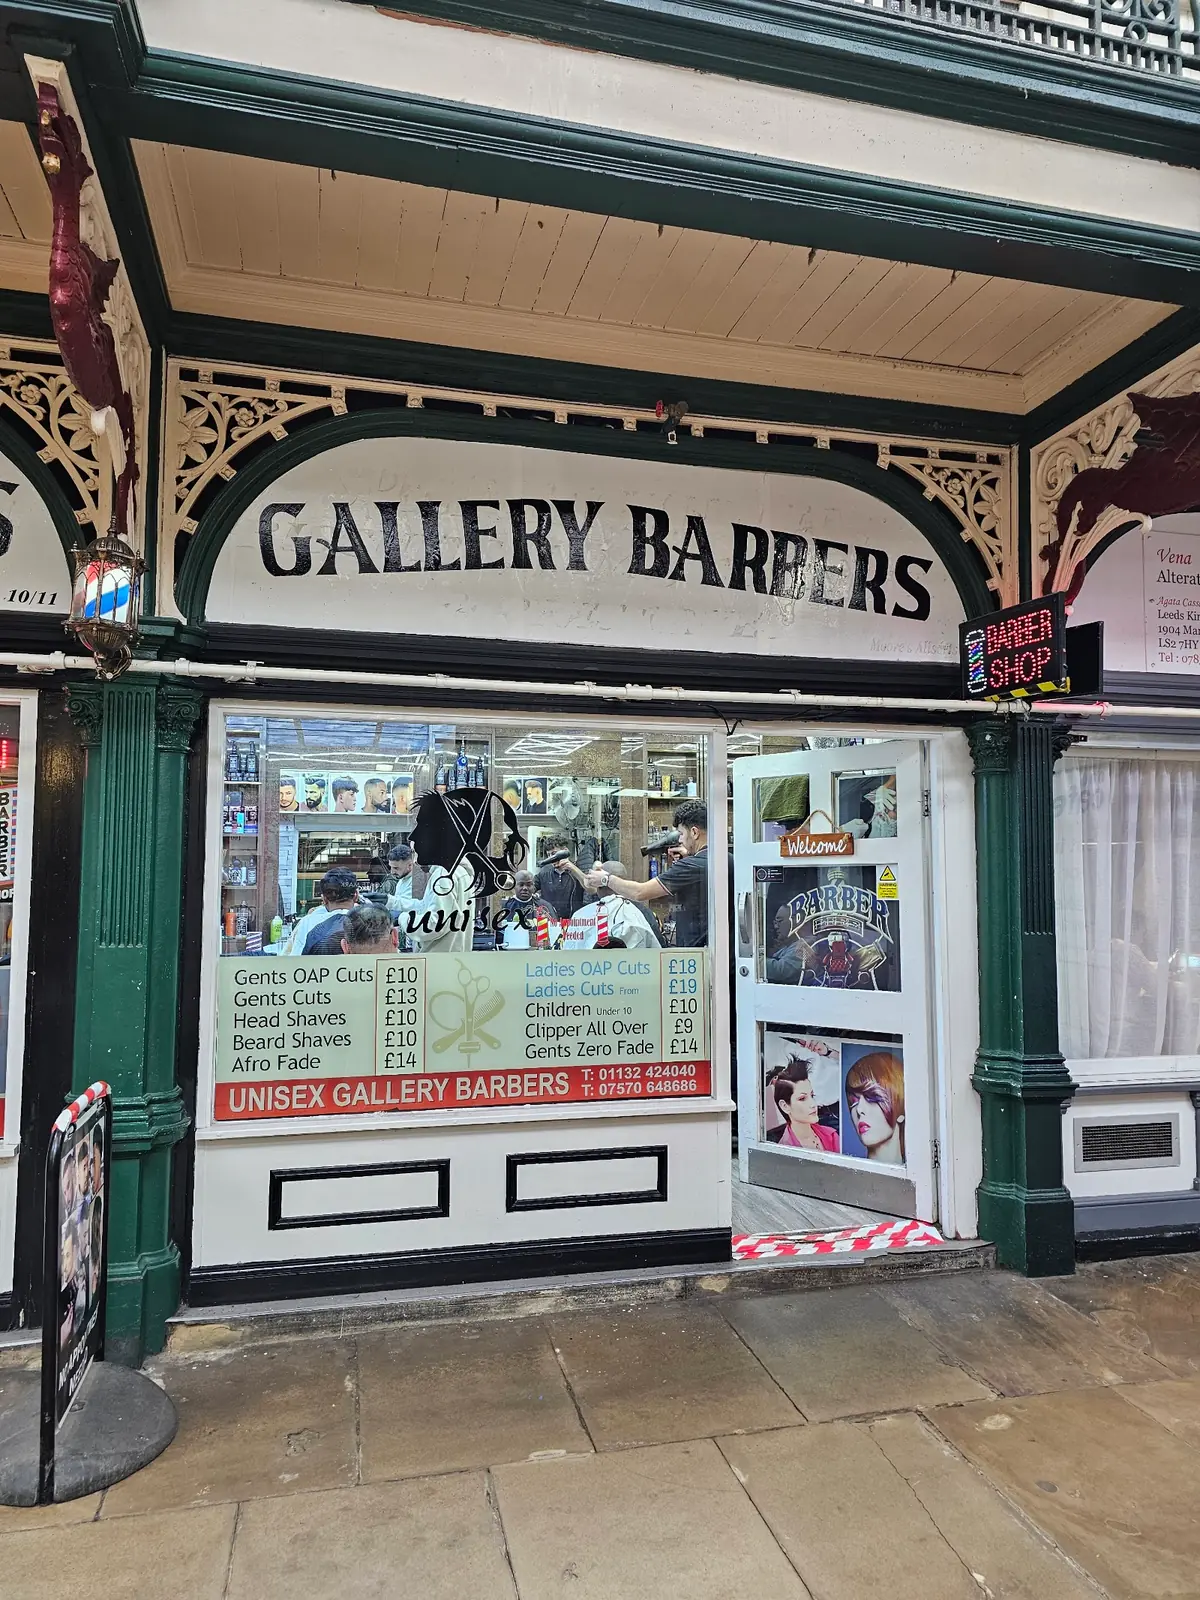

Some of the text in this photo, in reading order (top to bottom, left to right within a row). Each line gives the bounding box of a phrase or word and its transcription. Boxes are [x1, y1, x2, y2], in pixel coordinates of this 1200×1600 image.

[258, 498, 934, 622] GALLERY BARBERS
[1156, 547, 1192, 565] Vena
[7, 589, 58, 606] 10/11
[1156, 596, 1181, 607] Agata
[1157, 609, 1185, 620] Leeds
[987, 609, 1053, 655] BARBER
[1158, 625, 1181, 636] 1904
[1158, 638, 1199, 650] LS2 7HY
[990, 646, 1052, 688] SHOP
[1158, 652, 1174, 663] Tel
[1181, 653, 1200, 666] 078
[787, 835, 848, 856] Welcome
[406, 900, 533, 934] unisex
[787, 884, 894, 944] BARBER
[234, 966, 418, 986] Gents OAP Cuts £10
[525, 958, 697, 978] Ladies OAP Cuts £18
[234, 988, 418, 1008] Gents Cuts £13
[525, 978, 697, 998] Ladies Cuts From £19
[233, 1008, 417, 1029] Head Shaves £10
[525, 998, 698, 1019] Children Under 10 £10
[233, 1029, 417, 1051] Beard Shaves £10
[525, 1018, 693, 1042] Clipper All Over £9
[525, 1038, 698, 1060] Gents Zero Fade £14
[232, 1051, 417, 1073] Afro Fade £14
[581, 1064, 696, 1082] T: 01132 424040
[228, 1072, 570, 1113] UNISEX GALLERY BARBERS
[581, 1079, 697, 1097] T: 07570 648686
